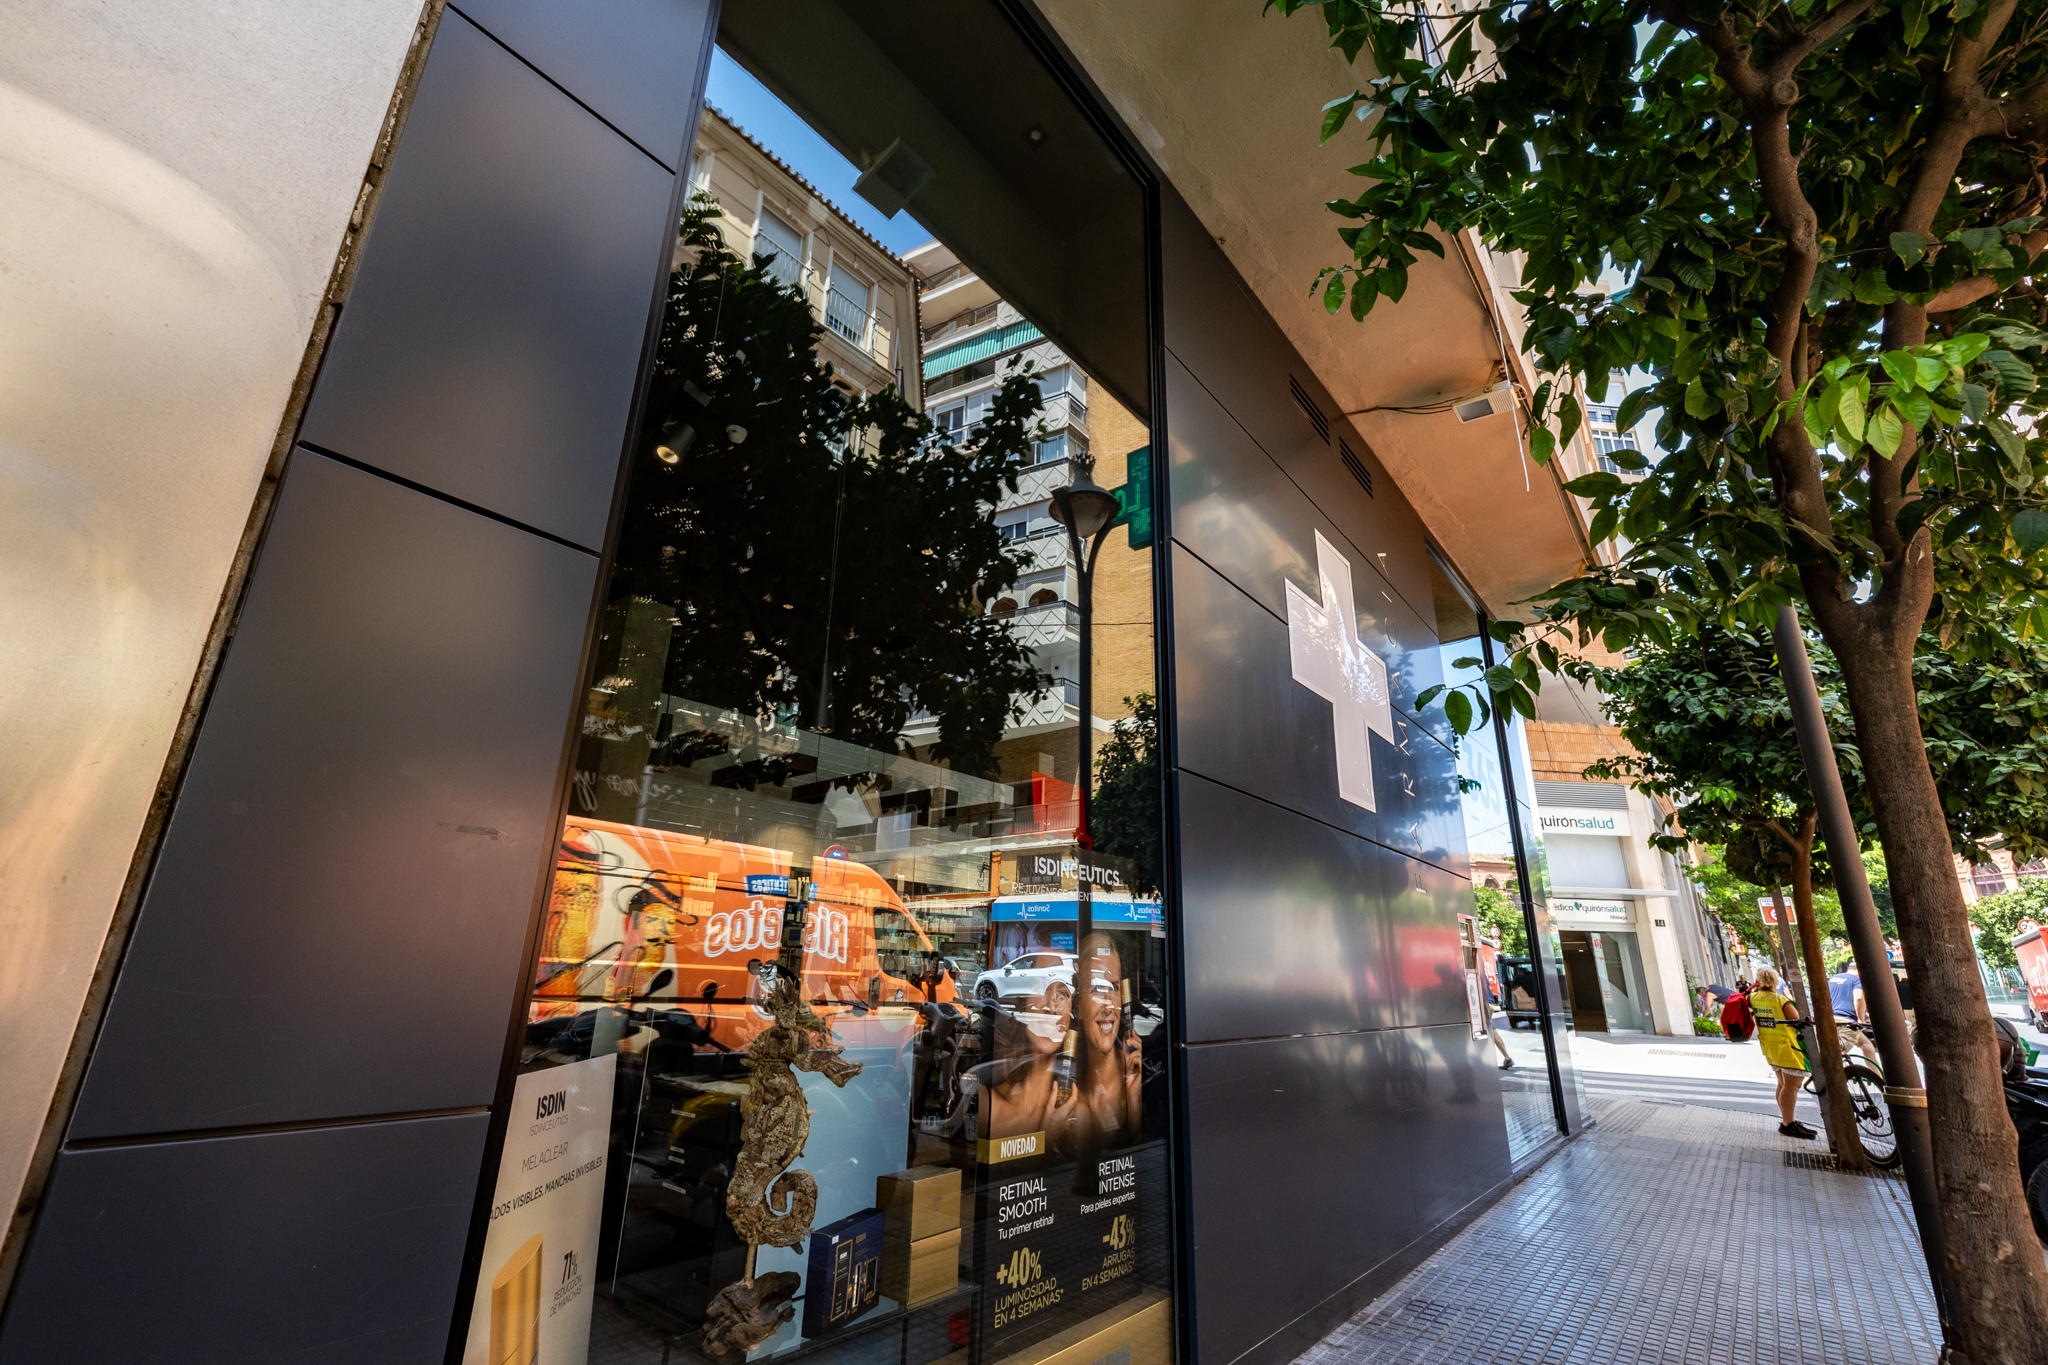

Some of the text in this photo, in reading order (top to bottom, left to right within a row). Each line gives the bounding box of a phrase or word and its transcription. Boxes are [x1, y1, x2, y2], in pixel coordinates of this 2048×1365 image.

[1034, 856, 1120, 886] ISDINCEUTICS
[1011, 881, 1068, 900] REJUVENECE
[1071, 890, 1108, 905] MIENTRAS
[1582, 903, 1627, 913] quirónsalud
[536, 1090, 567, 1120] ISDIN
[528, 1113, 569, 1137] ISDINCEUTICS
[521, 1141, 569, 1174] MELACLEAR
[1000, 1135, 1036, 1159] NOVEDAD
[544, 1170, 576, 1195] MANCHAS
[575, 1156, 603, 1179] INVISIBLES
[1098, 1155, 1136, 1177] RETINAL
[999, 1177, 1047, 1202] RETINAL
[1098, 1172, 1136, 1195] INTENSE
[998, 1195, 1047, 1223] SMOOTH
[1080, 1191, 1136, 1214] Para pieles expertas
[998, 1213, 1054, 1240] Tu primer retinal
[1102, 1214, 1136, 1251] -43%
[561, 1249, 579, 1285] 71%
[996, 1246, 1042, 1289] +40%
[1102, 1248, 1136, 1269] ARRUGAS
[1082, 1278, 1093, 1291] EN
[1093, 1274, 1099, 1286] 4
[994, 1277, 1057, 1313] LUMINOSIDAD
[549, 1303, 558, 1318] DE
[994, 1313, 1008, 1329] EN
[1009, 1308, 1016, 1320] 4
